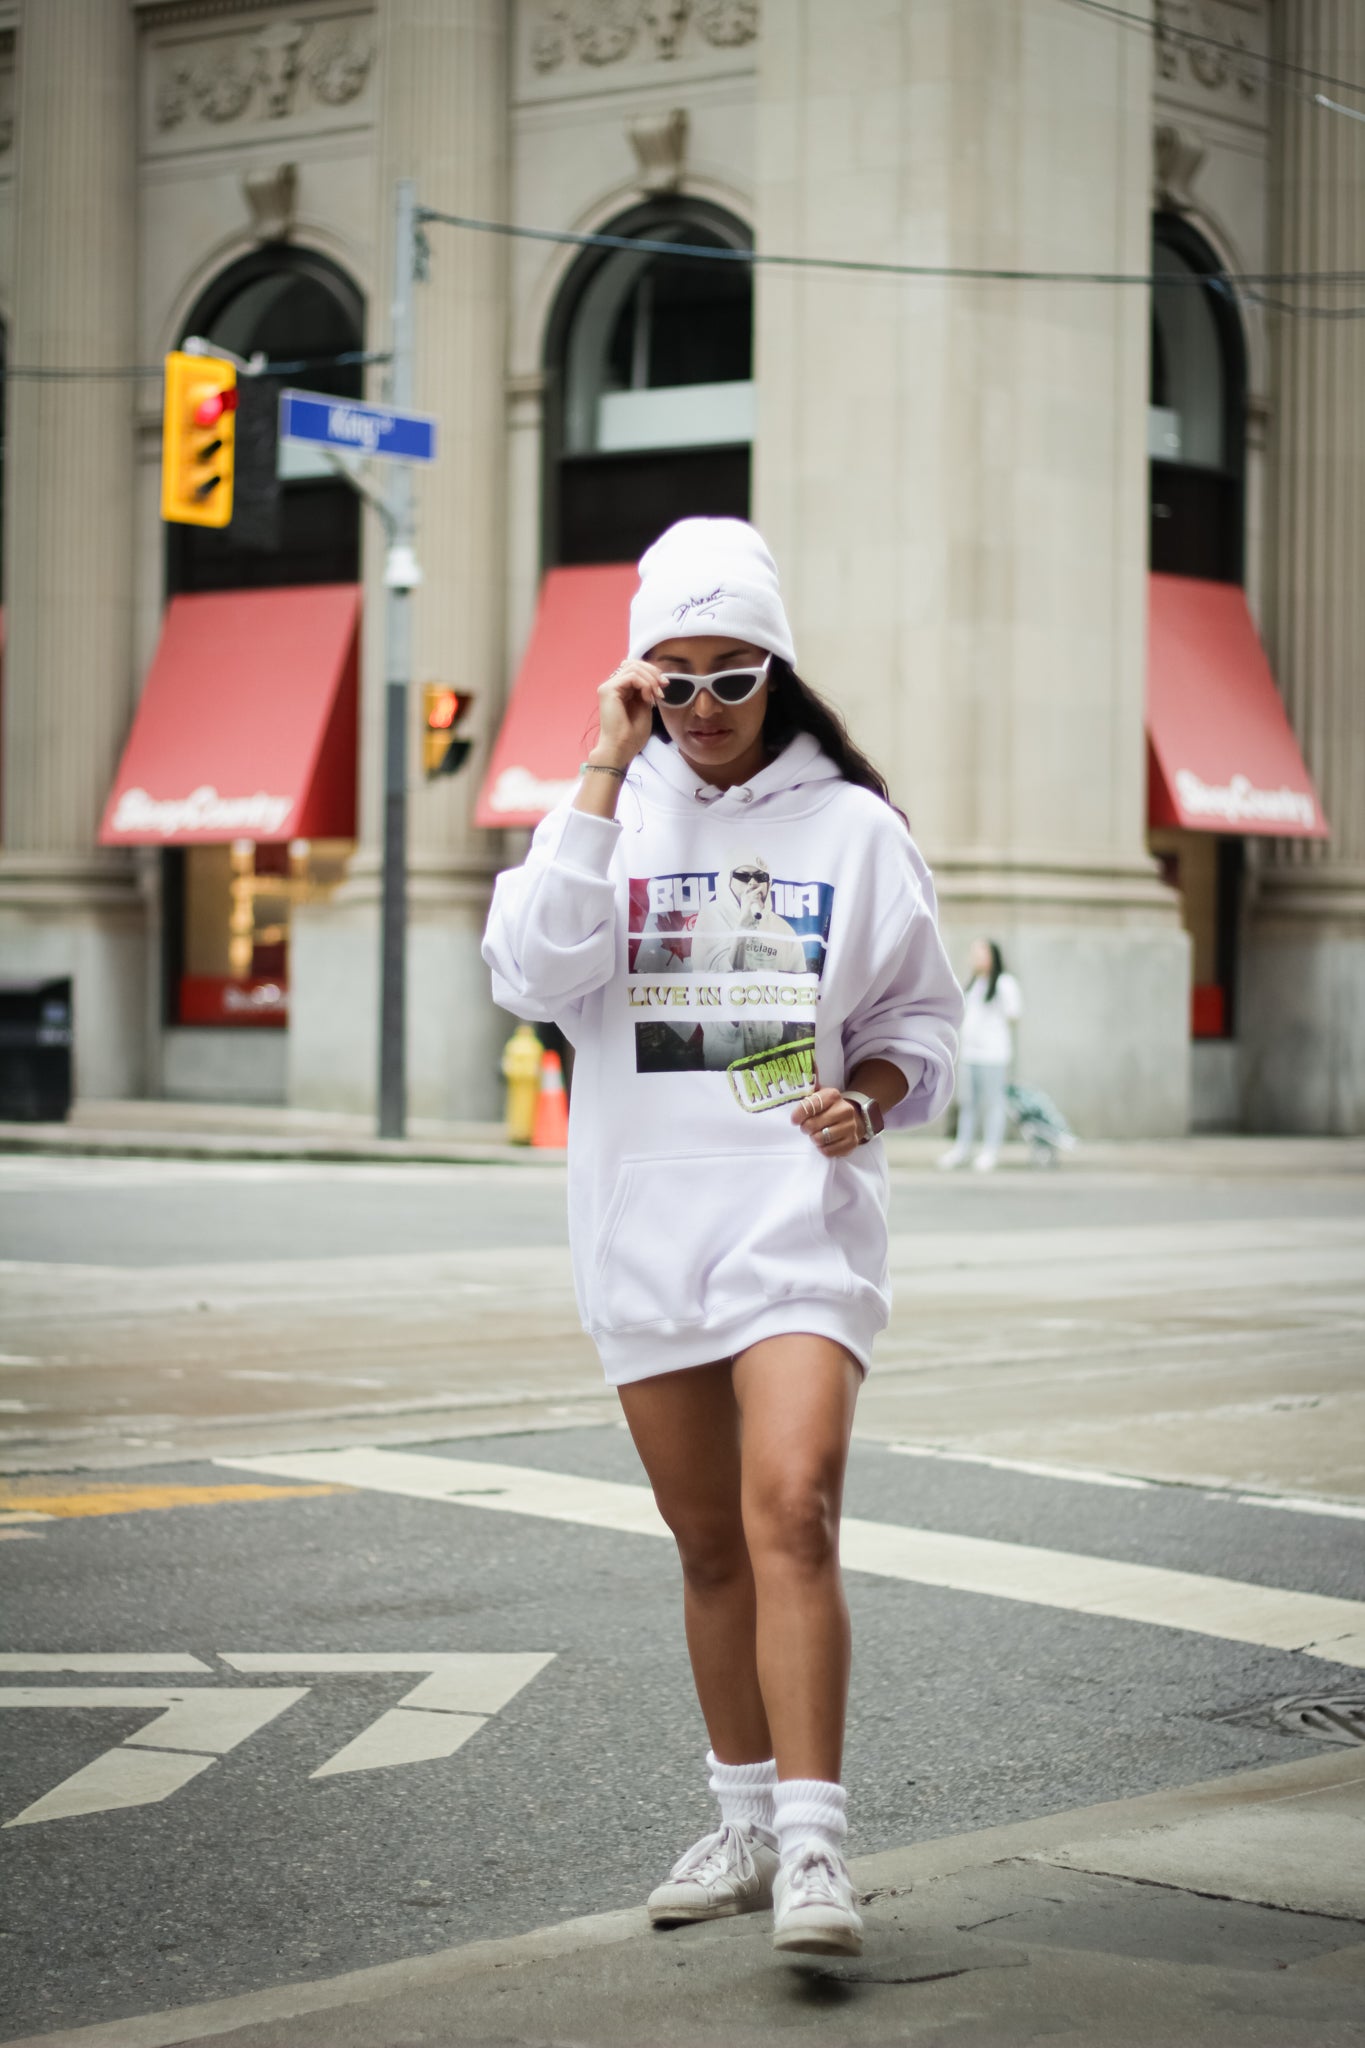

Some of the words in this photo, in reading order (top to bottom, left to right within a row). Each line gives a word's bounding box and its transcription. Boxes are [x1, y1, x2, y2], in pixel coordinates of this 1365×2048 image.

[627, 986, 690, 1006] LIVE
[696, 986, 722, 1006] IN
[729, 984, 817, 1006] CONCE
[741, 1048, 815, 1104] APPROV
